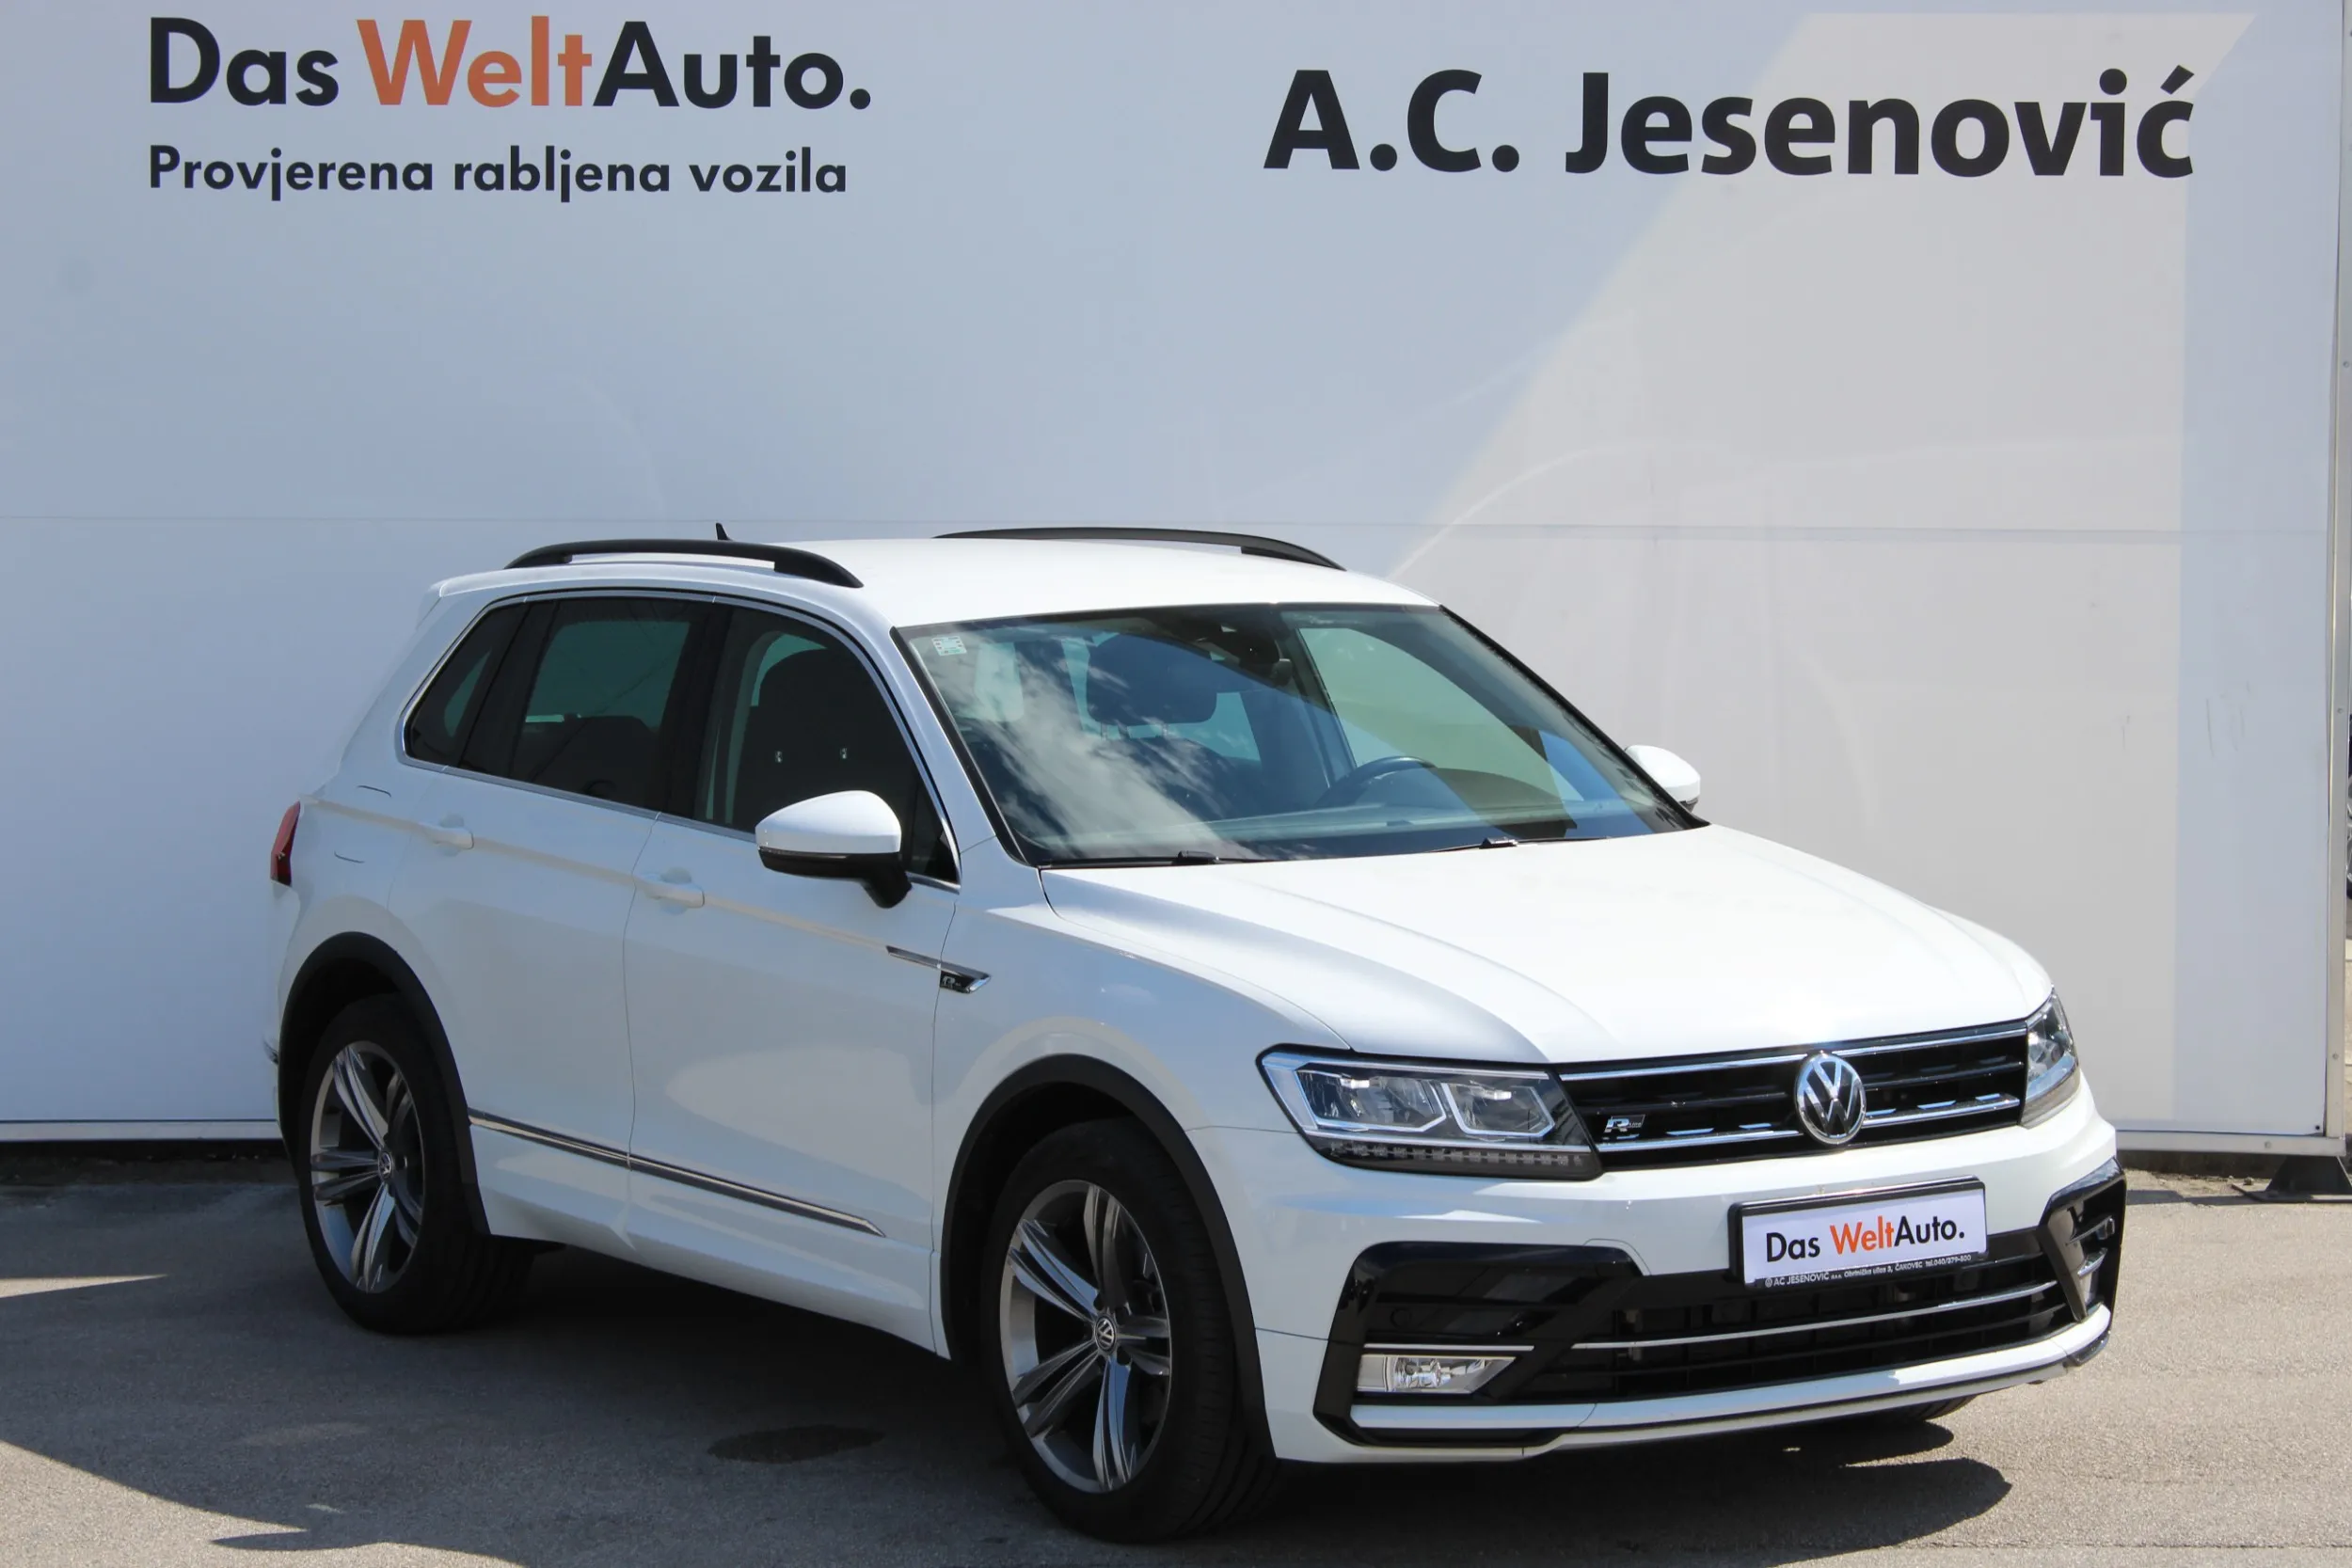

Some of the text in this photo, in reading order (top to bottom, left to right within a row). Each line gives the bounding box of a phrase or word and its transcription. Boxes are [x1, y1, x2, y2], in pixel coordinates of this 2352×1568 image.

[150, 15, 871, 109] Das WeltAuto.
[1263, 64, 2195, 179] A.C. Jesenović
[150, 144, 847, 204] Provjerena rabljena vozila
[1765, 1215, 1965, 1262] Das WeltAuto.
[1772, 1277, 1786, 1288] AC
